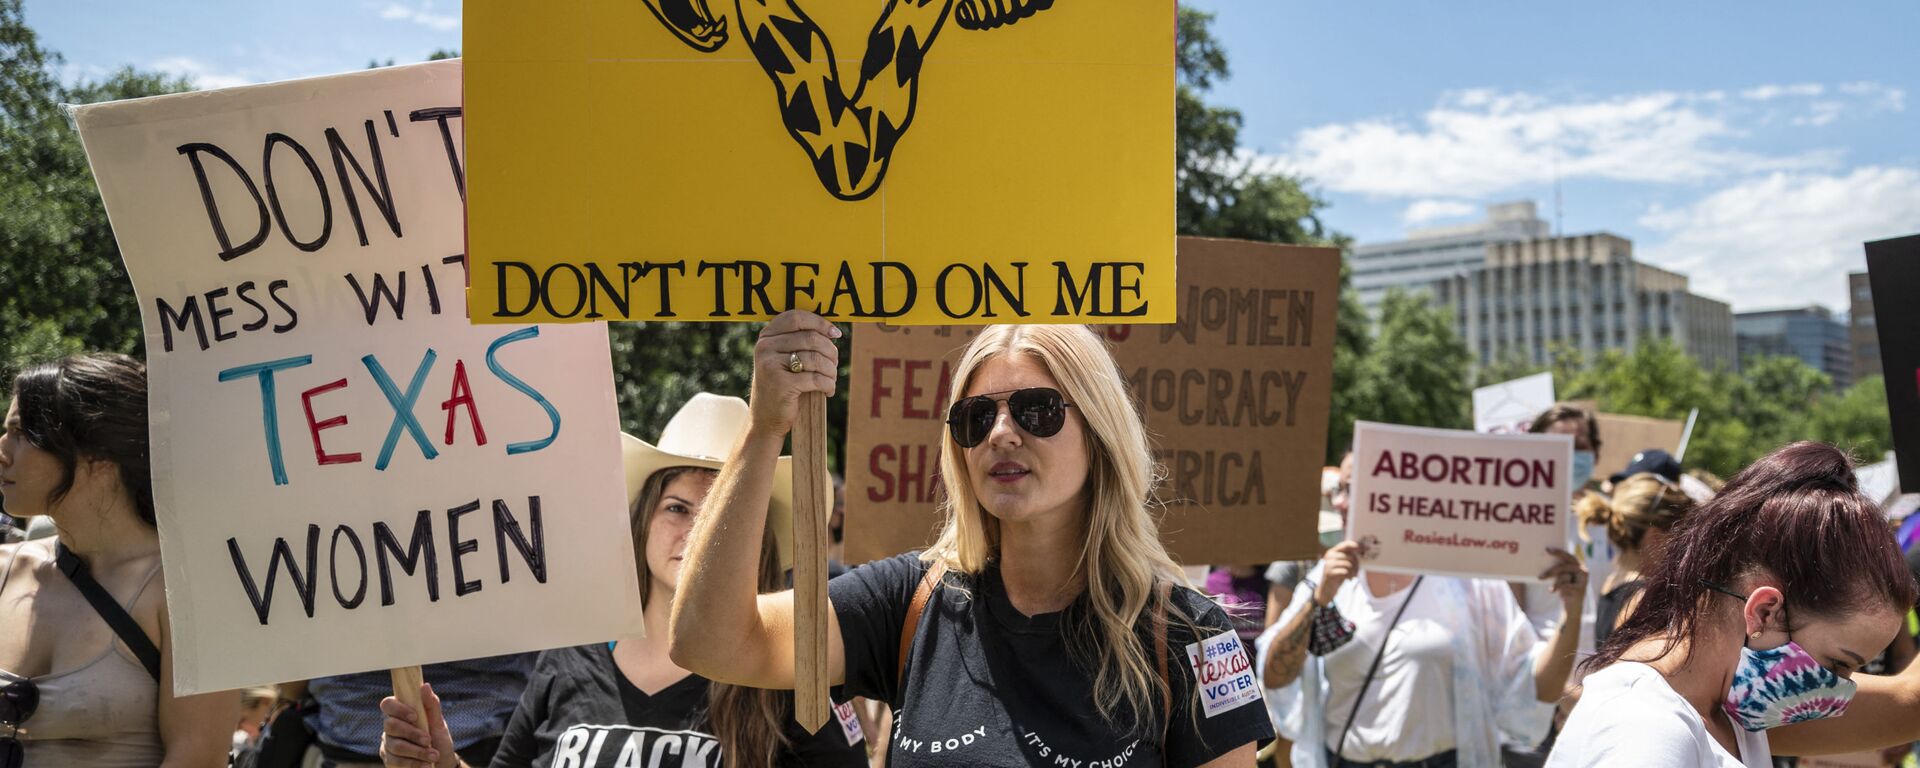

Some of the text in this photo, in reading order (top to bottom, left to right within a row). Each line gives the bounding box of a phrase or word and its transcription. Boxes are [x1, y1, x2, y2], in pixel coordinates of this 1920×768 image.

[177, 108, 463, 261] DON'T
[156, 255, 465, 352] MESS WI
[491, 260, 1149, 319] DON'T TREAD ON ME
[1159, 285, 1316, 346] WOMEN
[218, 325, 562, 486] TEXAS
[1371, 449, 1556, 489] ABORTION
[1369, 492, 1556, 525] IS HEALTHCARE
[227, 495, 547, 625] WOMEN
[1403, 529, 1519, 555] RosiesLaw.org
[1193, 650, 1250, 685] texas
[1206, 637, 1240, 659] #BeA
[1206, 674, 1253, 700] VOTER
[552, 727, 719, 768] BLACK
[900, 735, 923, 753] MY
[930, 725, 986, 753] BODY
[1024, 731, 1052, 758] IT'S
